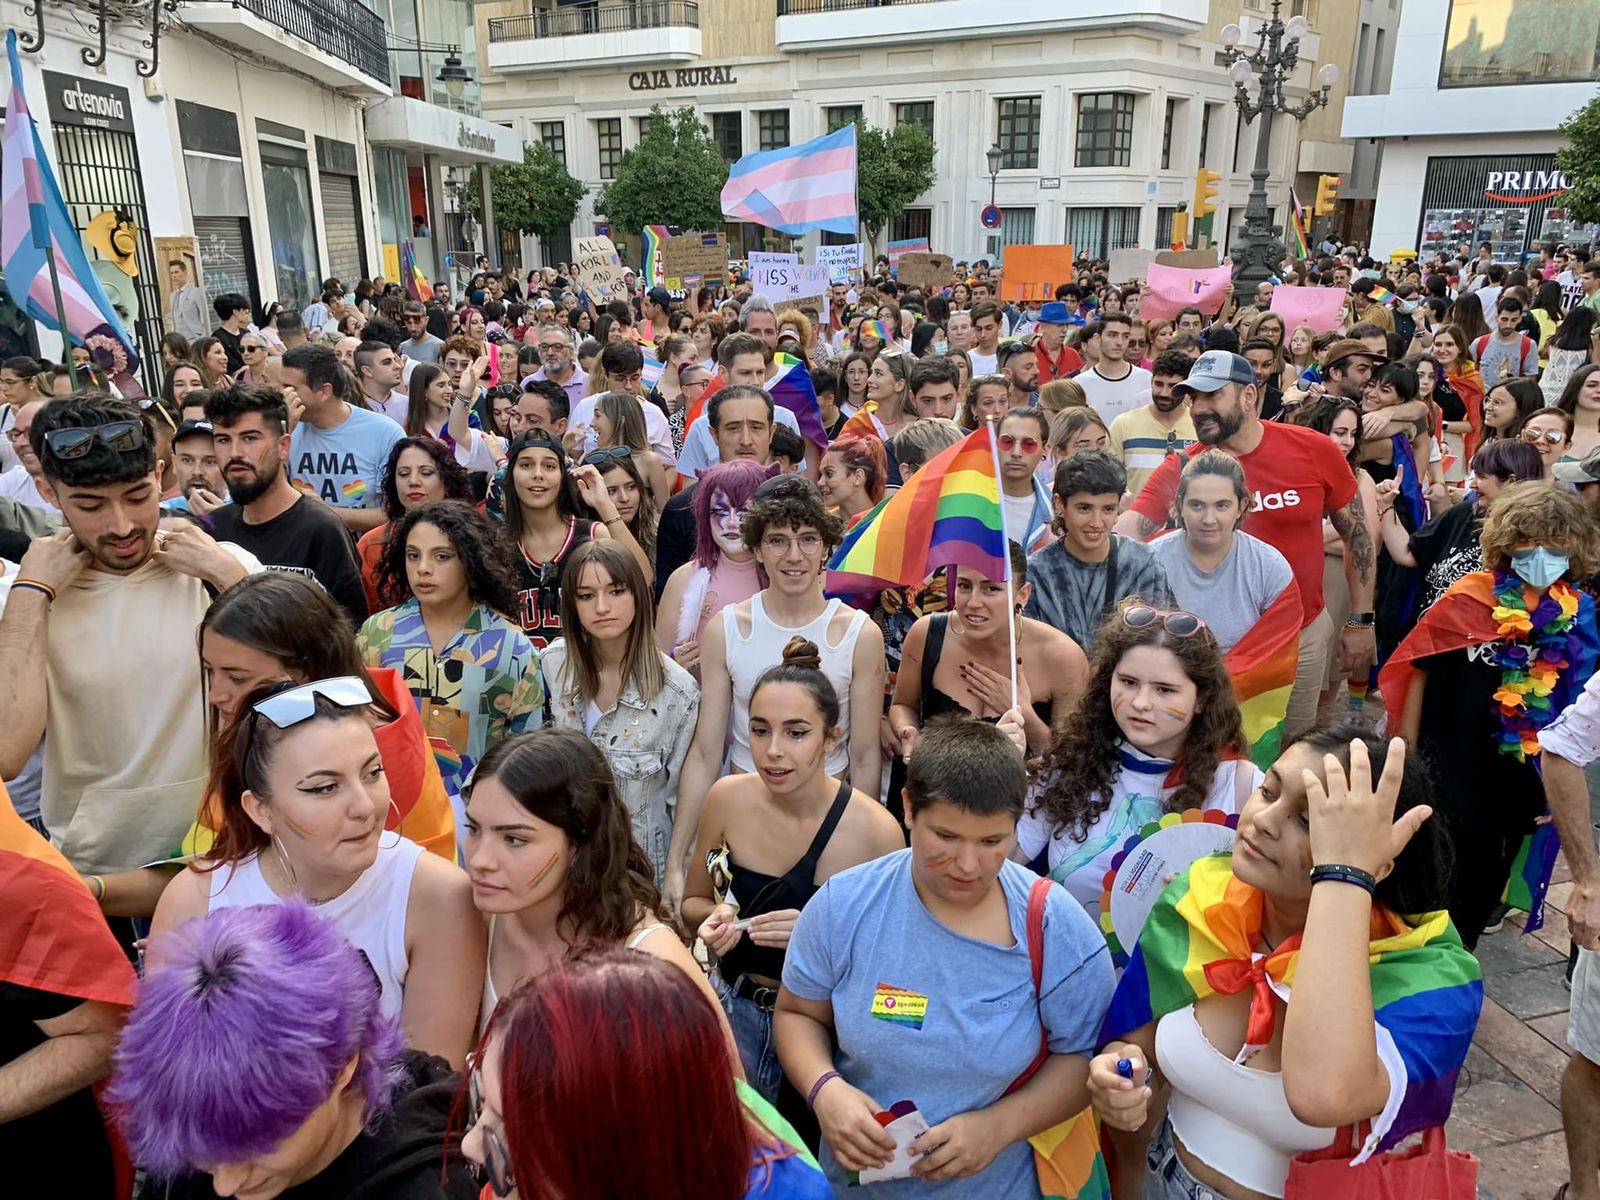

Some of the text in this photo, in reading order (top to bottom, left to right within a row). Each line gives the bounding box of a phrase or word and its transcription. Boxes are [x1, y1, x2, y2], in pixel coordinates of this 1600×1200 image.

[628, 65, 737, 91] CAJA RURAL
[63, 80, 124, 119] artenovia
[579, 239, 609, 255] ALL
[580, 256, 602, 270] FOR
[758, 268, 788, 287] KISS
[297, 452, 359, 475] AMA
[320, 478, 339, 503] A
